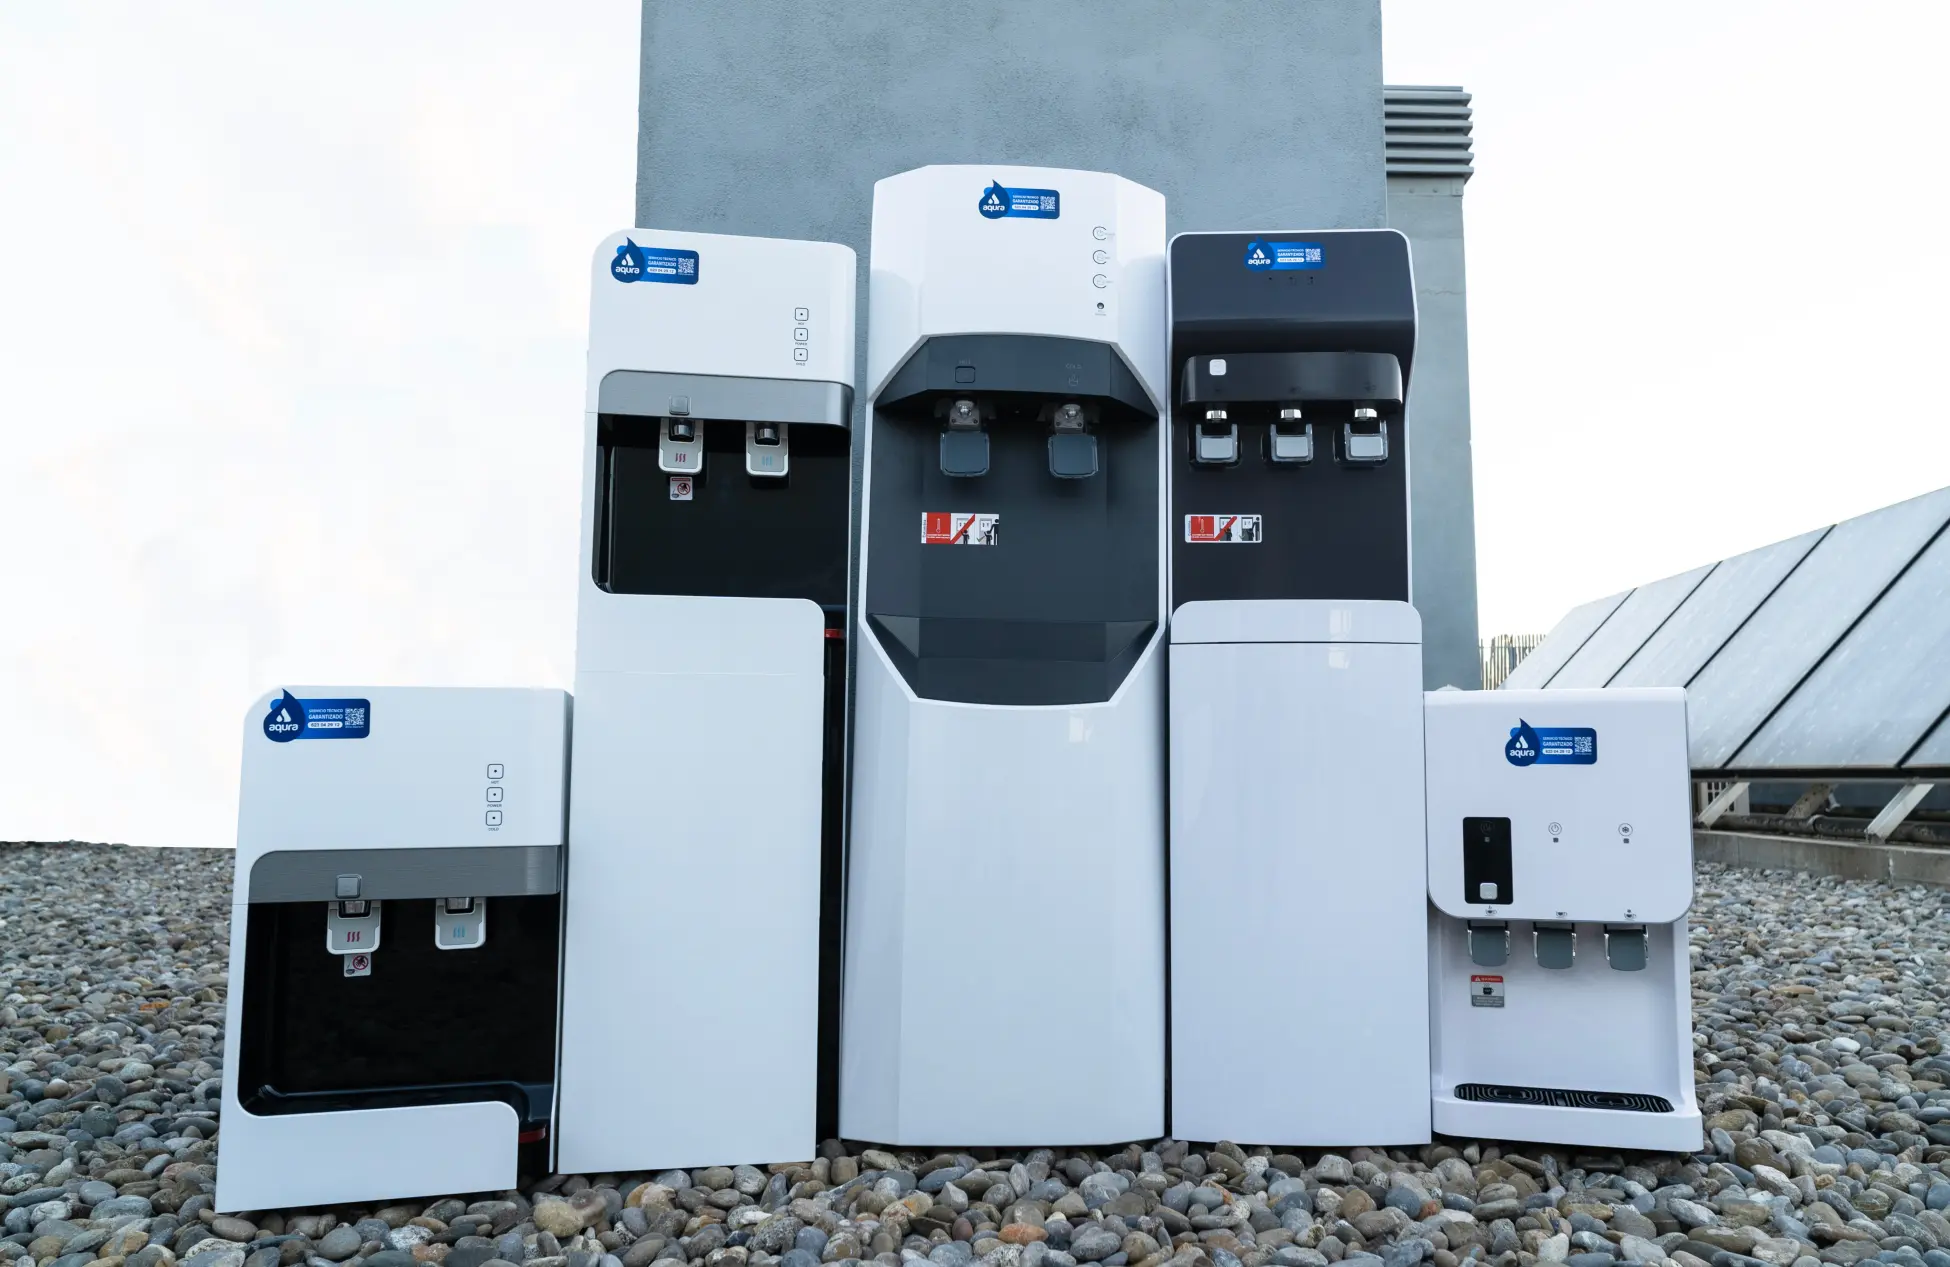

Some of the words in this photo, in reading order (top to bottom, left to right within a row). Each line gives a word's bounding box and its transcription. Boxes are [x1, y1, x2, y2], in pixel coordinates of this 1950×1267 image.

[616, 266, 640, 275] aqura
[269, 724, 299, 734] aqura
[1510, 750, 1535, 758] aqura
